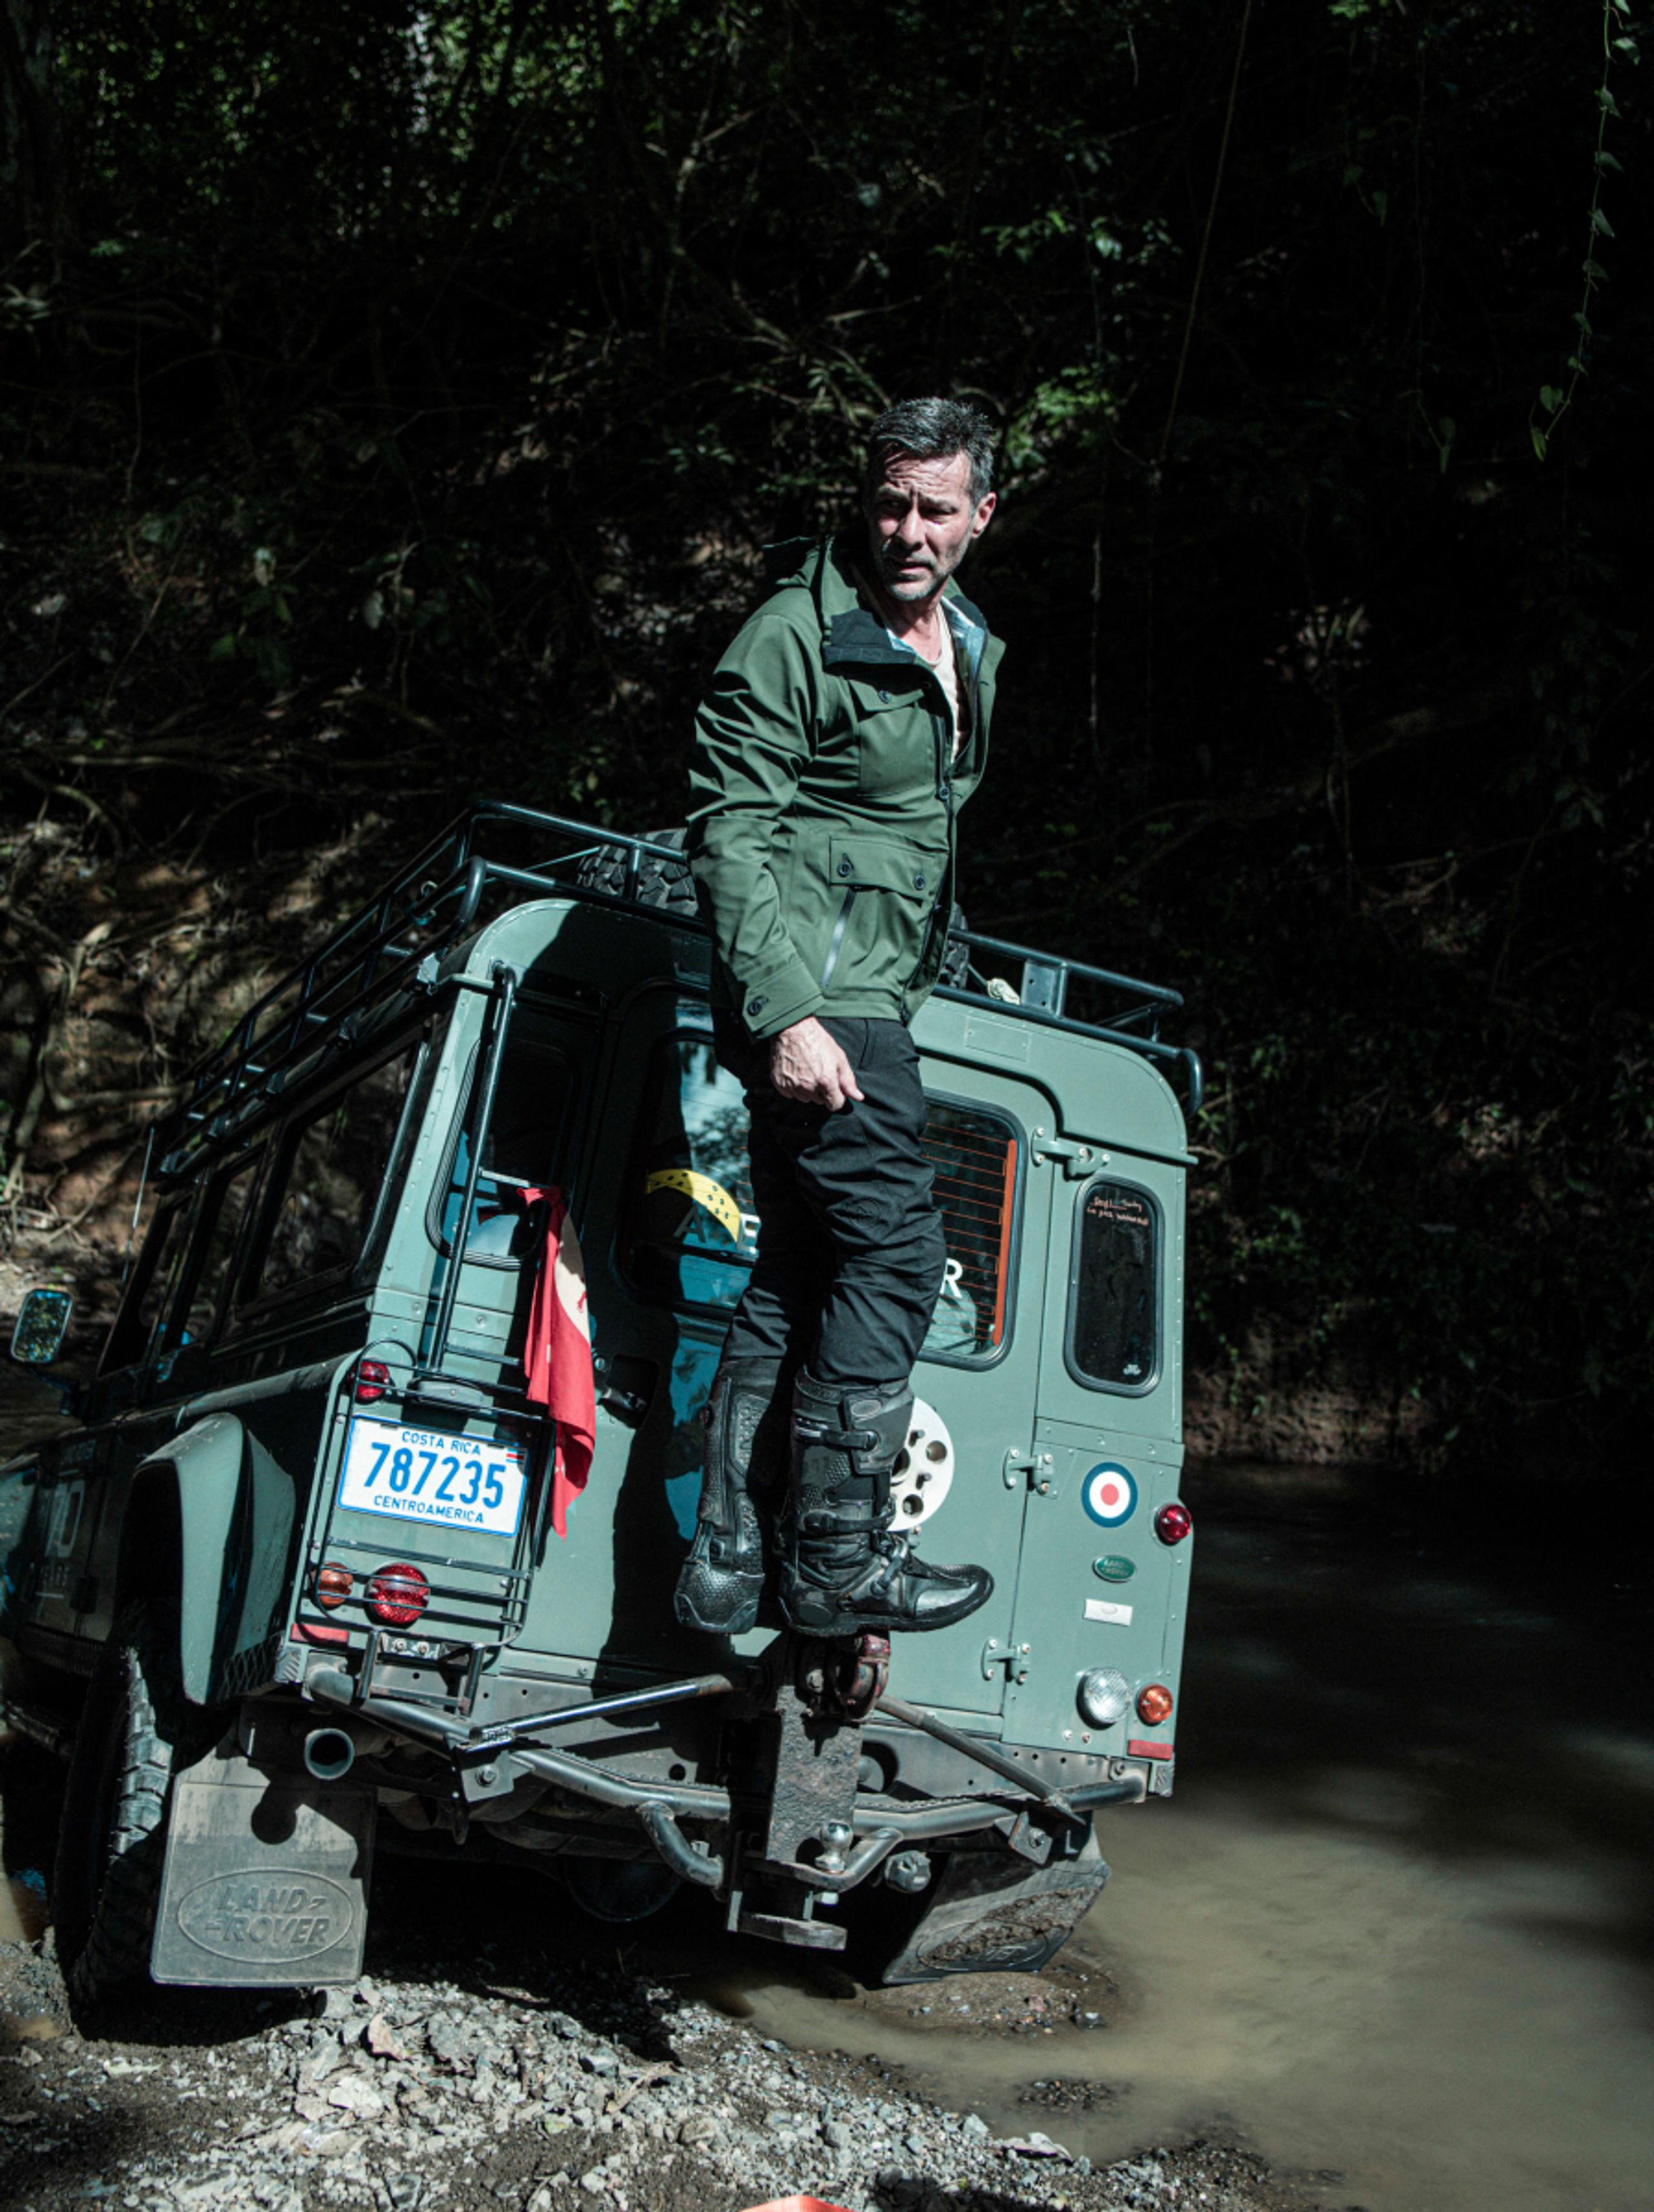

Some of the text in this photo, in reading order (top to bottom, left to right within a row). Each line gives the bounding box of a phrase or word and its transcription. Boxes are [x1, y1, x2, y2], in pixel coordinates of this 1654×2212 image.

[401, 1430, 481, 1456] COSTA RICA
[363, 1442, 507, 1509] 787235
[373, 1495, 485, 1524] CENTROAMERICA
[218, 1885, 308, 1914] LAND
[223, 1915, 330, 1944] ROVER
